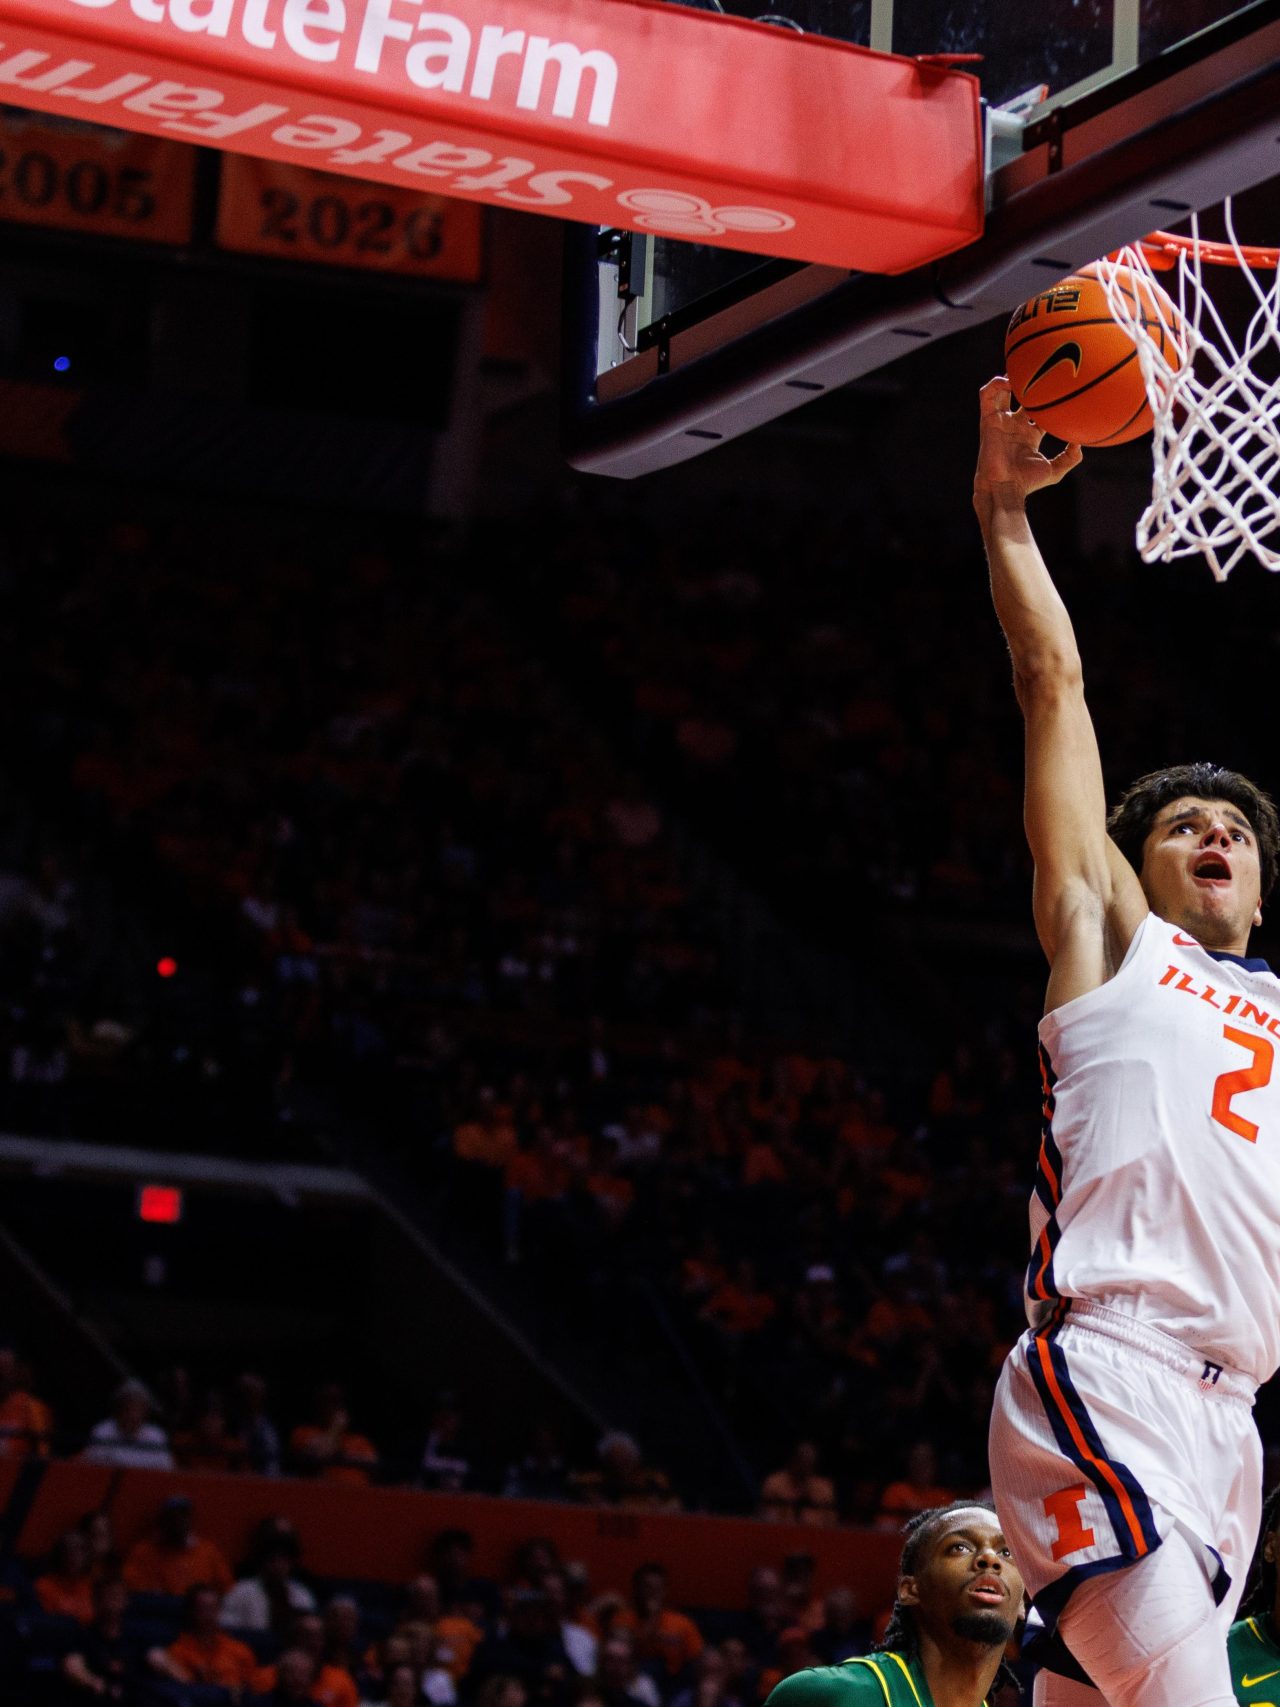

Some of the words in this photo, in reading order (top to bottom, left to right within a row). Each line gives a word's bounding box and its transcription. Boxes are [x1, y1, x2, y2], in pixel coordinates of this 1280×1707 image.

[0, 151, 154, 221] 005
[1211, 1024, 1274, 1144] 2
[1044, 1483, 1095, 1562] I
